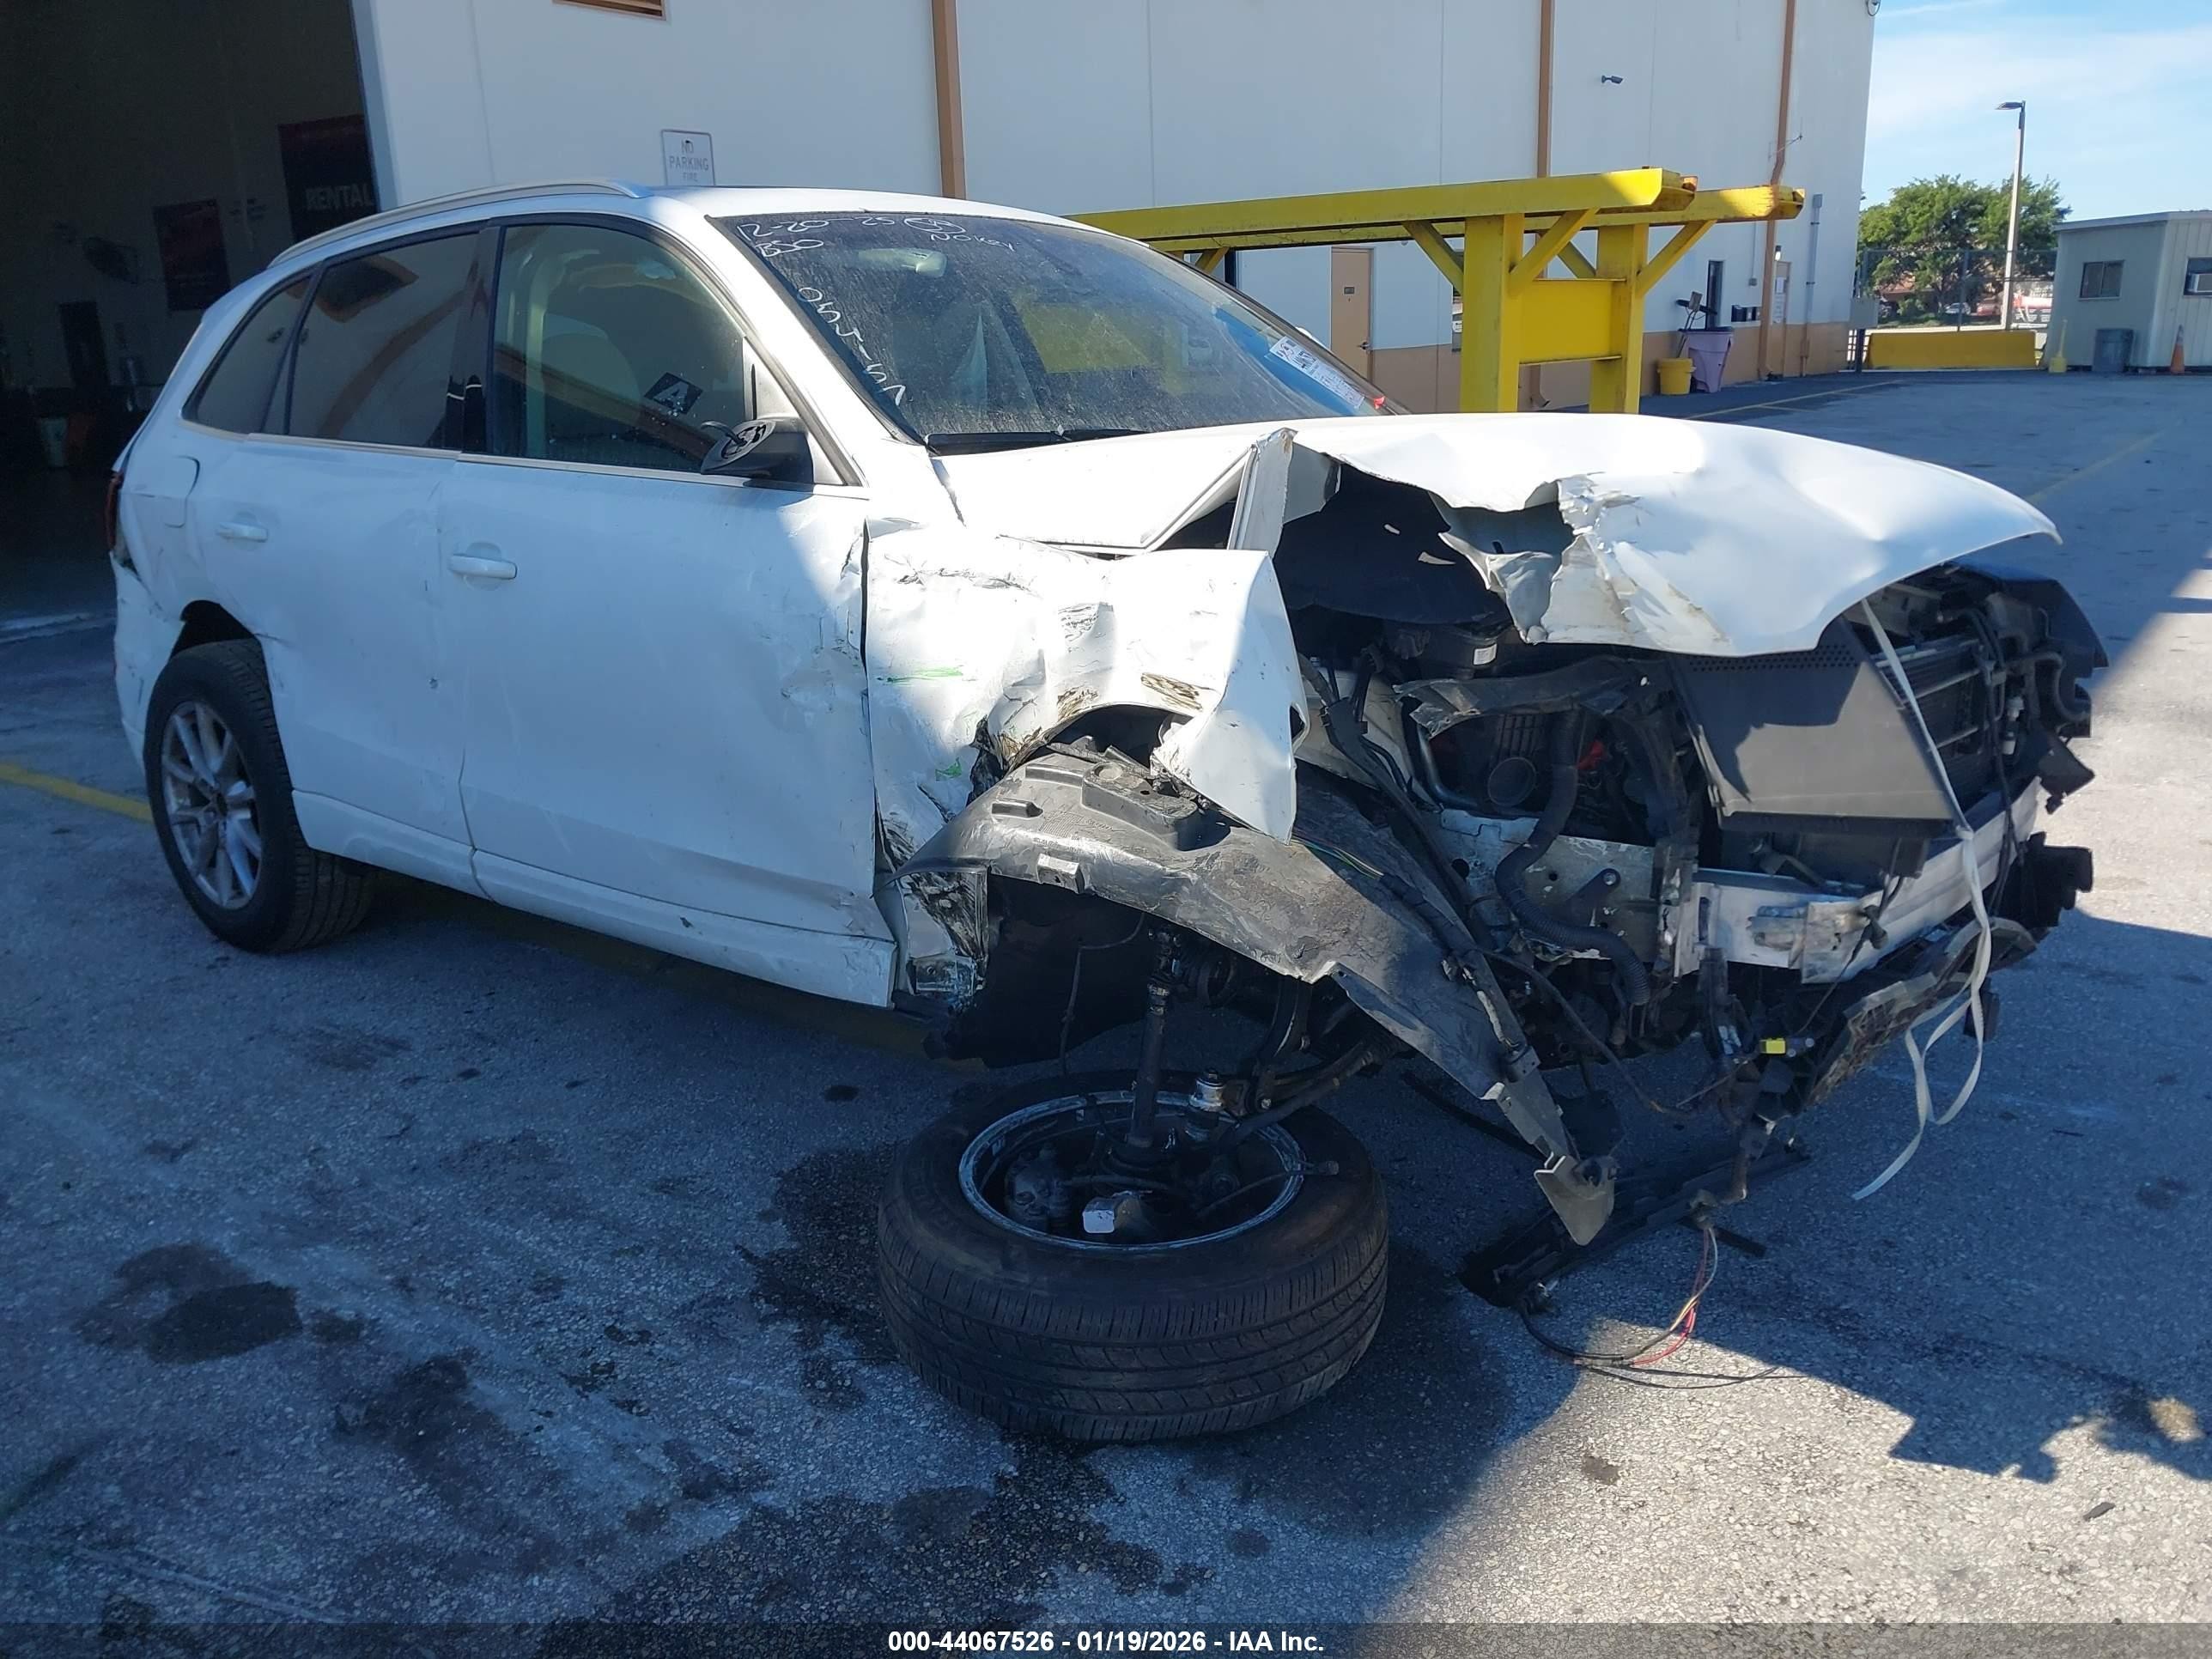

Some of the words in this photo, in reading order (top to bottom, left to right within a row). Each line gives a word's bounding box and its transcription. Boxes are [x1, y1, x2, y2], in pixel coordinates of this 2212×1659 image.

[681, 139, 694, 155] NO
[669, 155, 709, 171] PARKING
[305, 183, 374, 211] RENTAL
